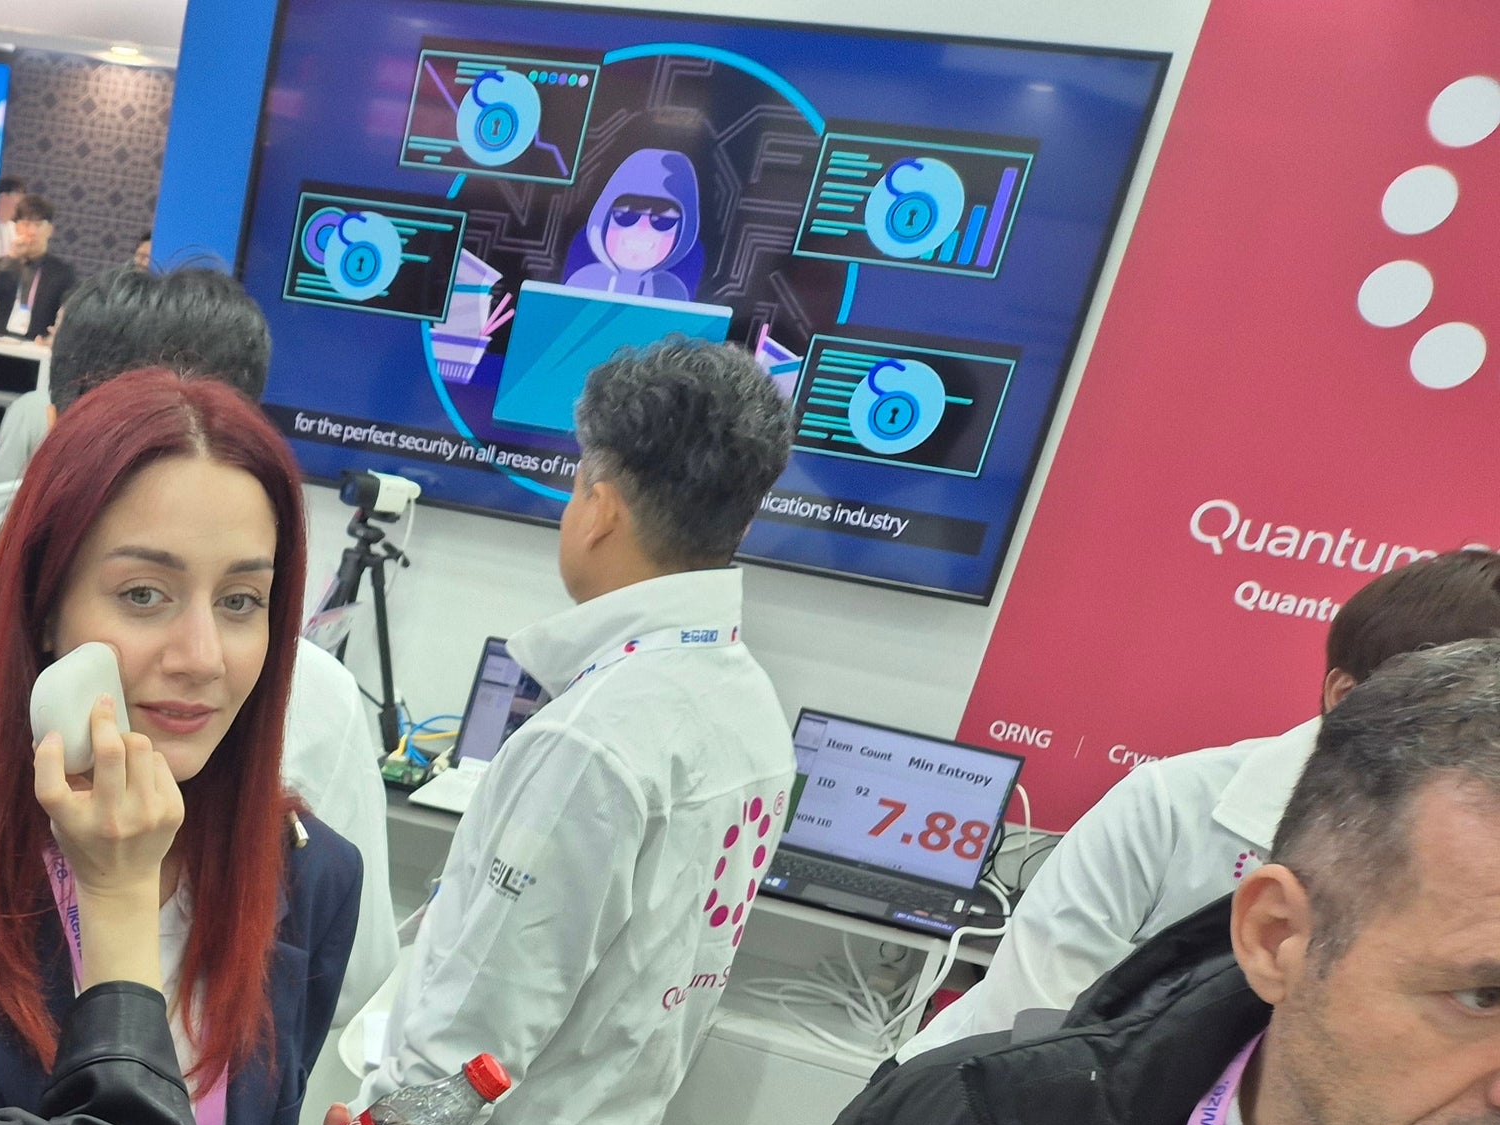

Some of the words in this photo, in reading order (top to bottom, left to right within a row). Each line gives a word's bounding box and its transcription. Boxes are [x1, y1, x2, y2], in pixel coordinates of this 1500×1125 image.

[294, 412, 313, 432] for
[317, 417, 343, 437] the
[342, 424, 398, 447] perfect
[397, 433, 459, 462] security
[459, 440, 476, 460] in
[475, 443, 495, 464] all
[496, 450, 539, 471] areas
[541, 454, 558, 473] of
[833, 503, 910, 538] industry
[989, 720, 1053, 749] QRNG
[817, 776, 836, 789] IID
[855, 785, 870, 797] 92
[826, 737, 853, 752] Item
[860, 746, 893, 762] Count
[908, 756, 934, 772] Min
[936, 763, 993, 787] Entropy
[867, 797, 991, 861] 7.88
